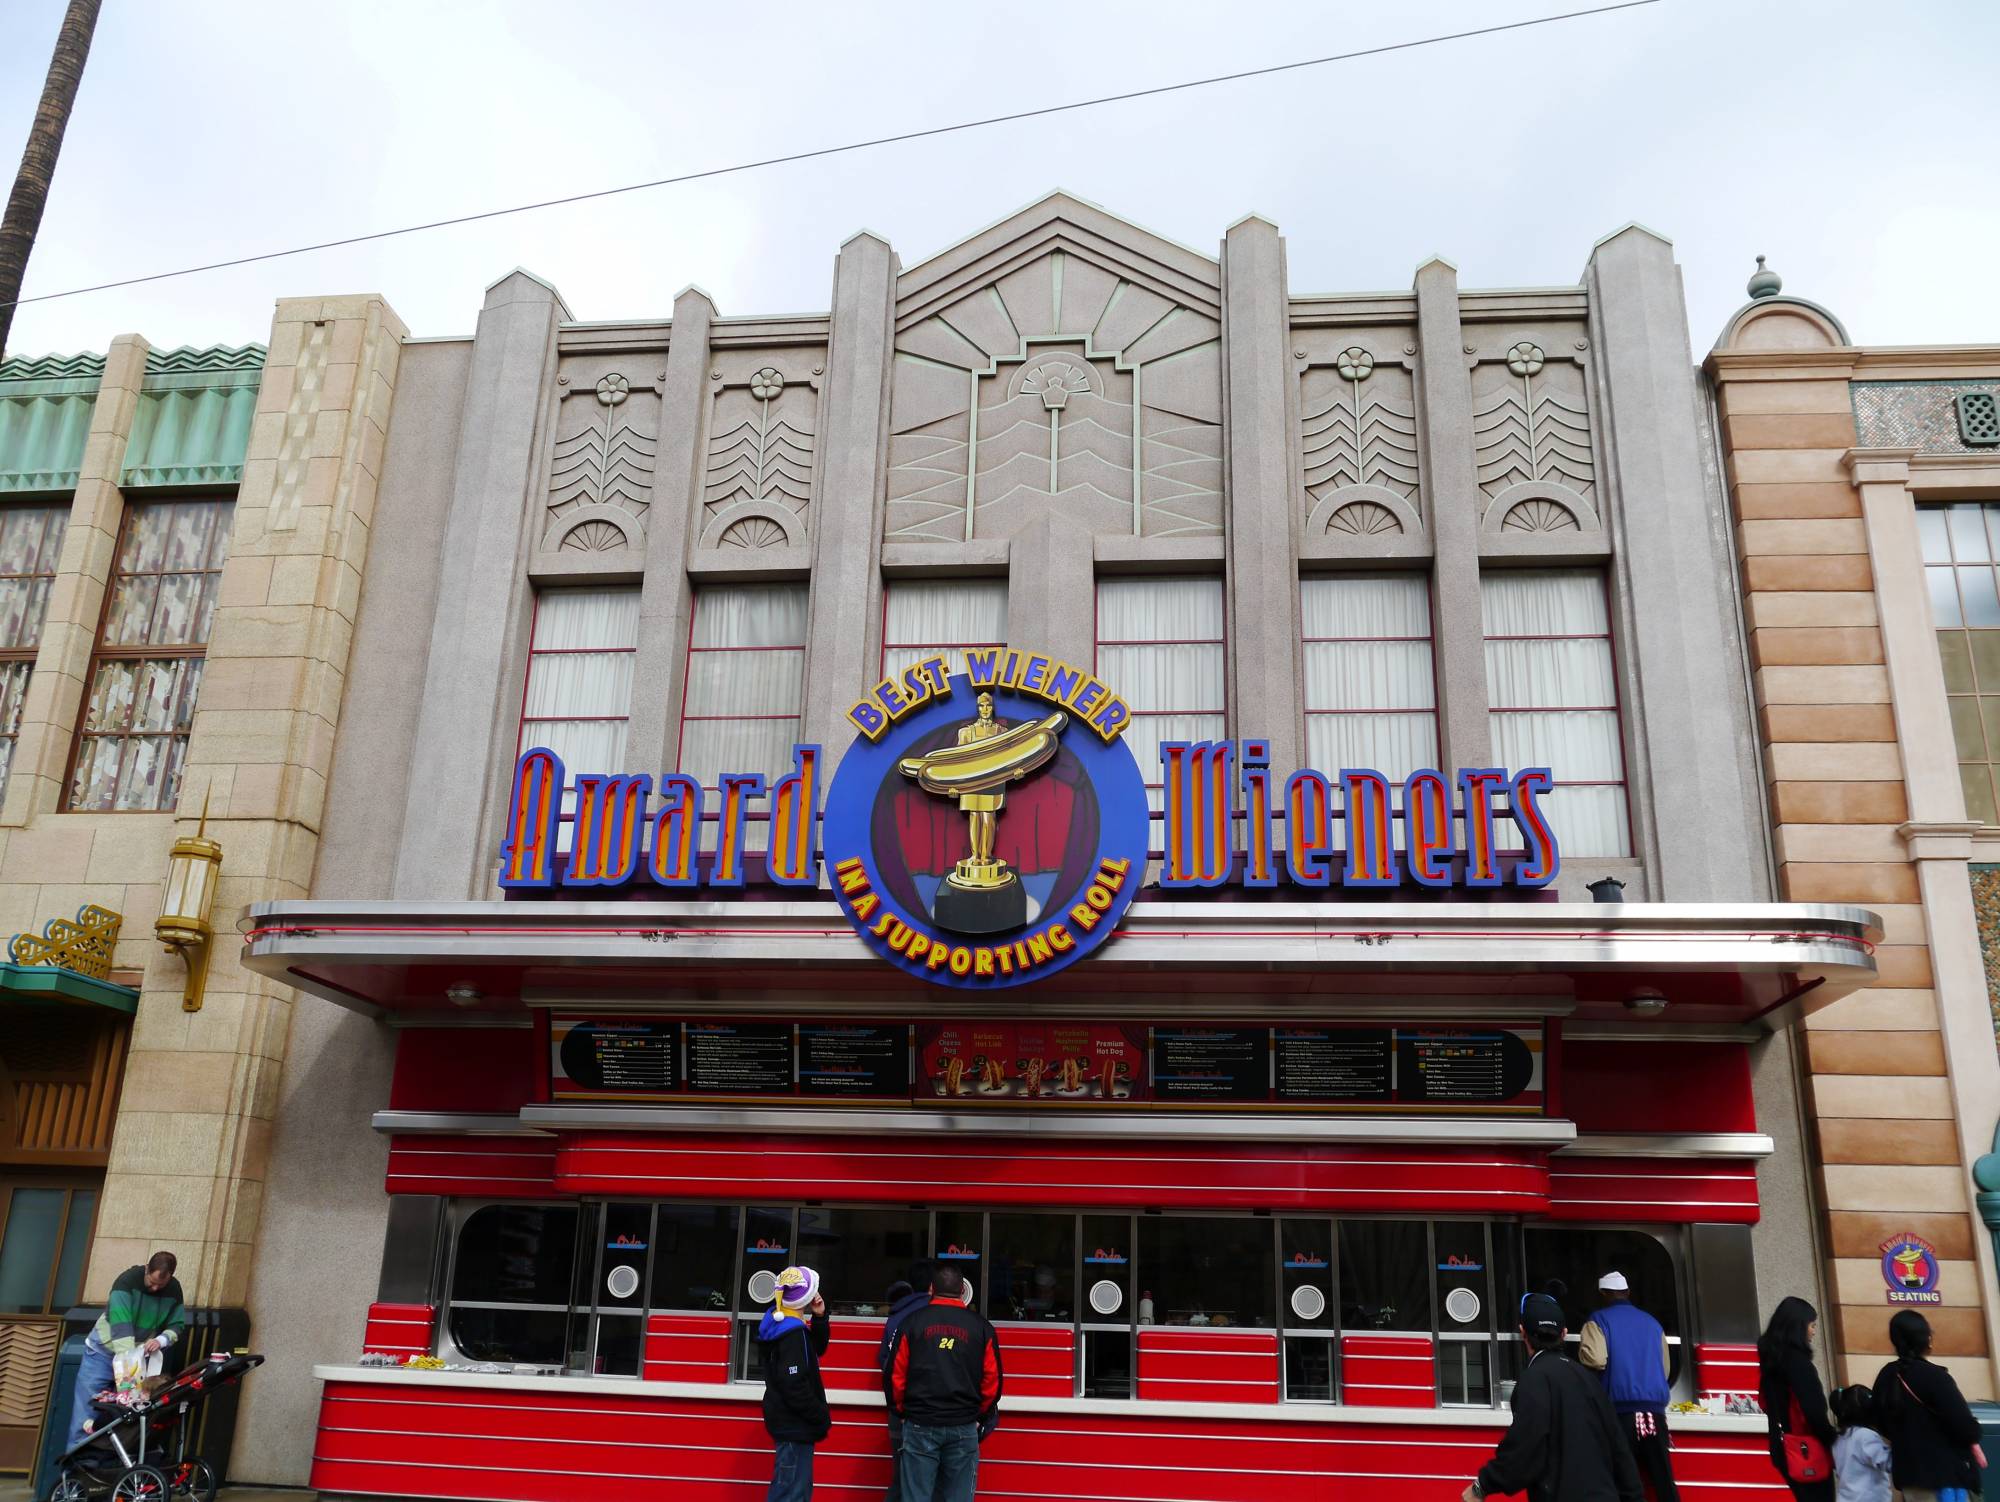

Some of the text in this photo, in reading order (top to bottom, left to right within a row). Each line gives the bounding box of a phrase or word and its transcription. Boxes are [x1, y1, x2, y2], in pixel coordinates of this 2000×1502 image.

[846, 647, 1131, 745] BEST WIENER
[500, 739, 1561, 889] Award Wieners
[835, 856, 1131, 976] IN A SUPPORTING ROLL
[1096, 1047, 1124, 1056] Hot Dog
[1889, 1292, 1940, 1302] SEATING
[938, 1337, 955, 1351] 24
